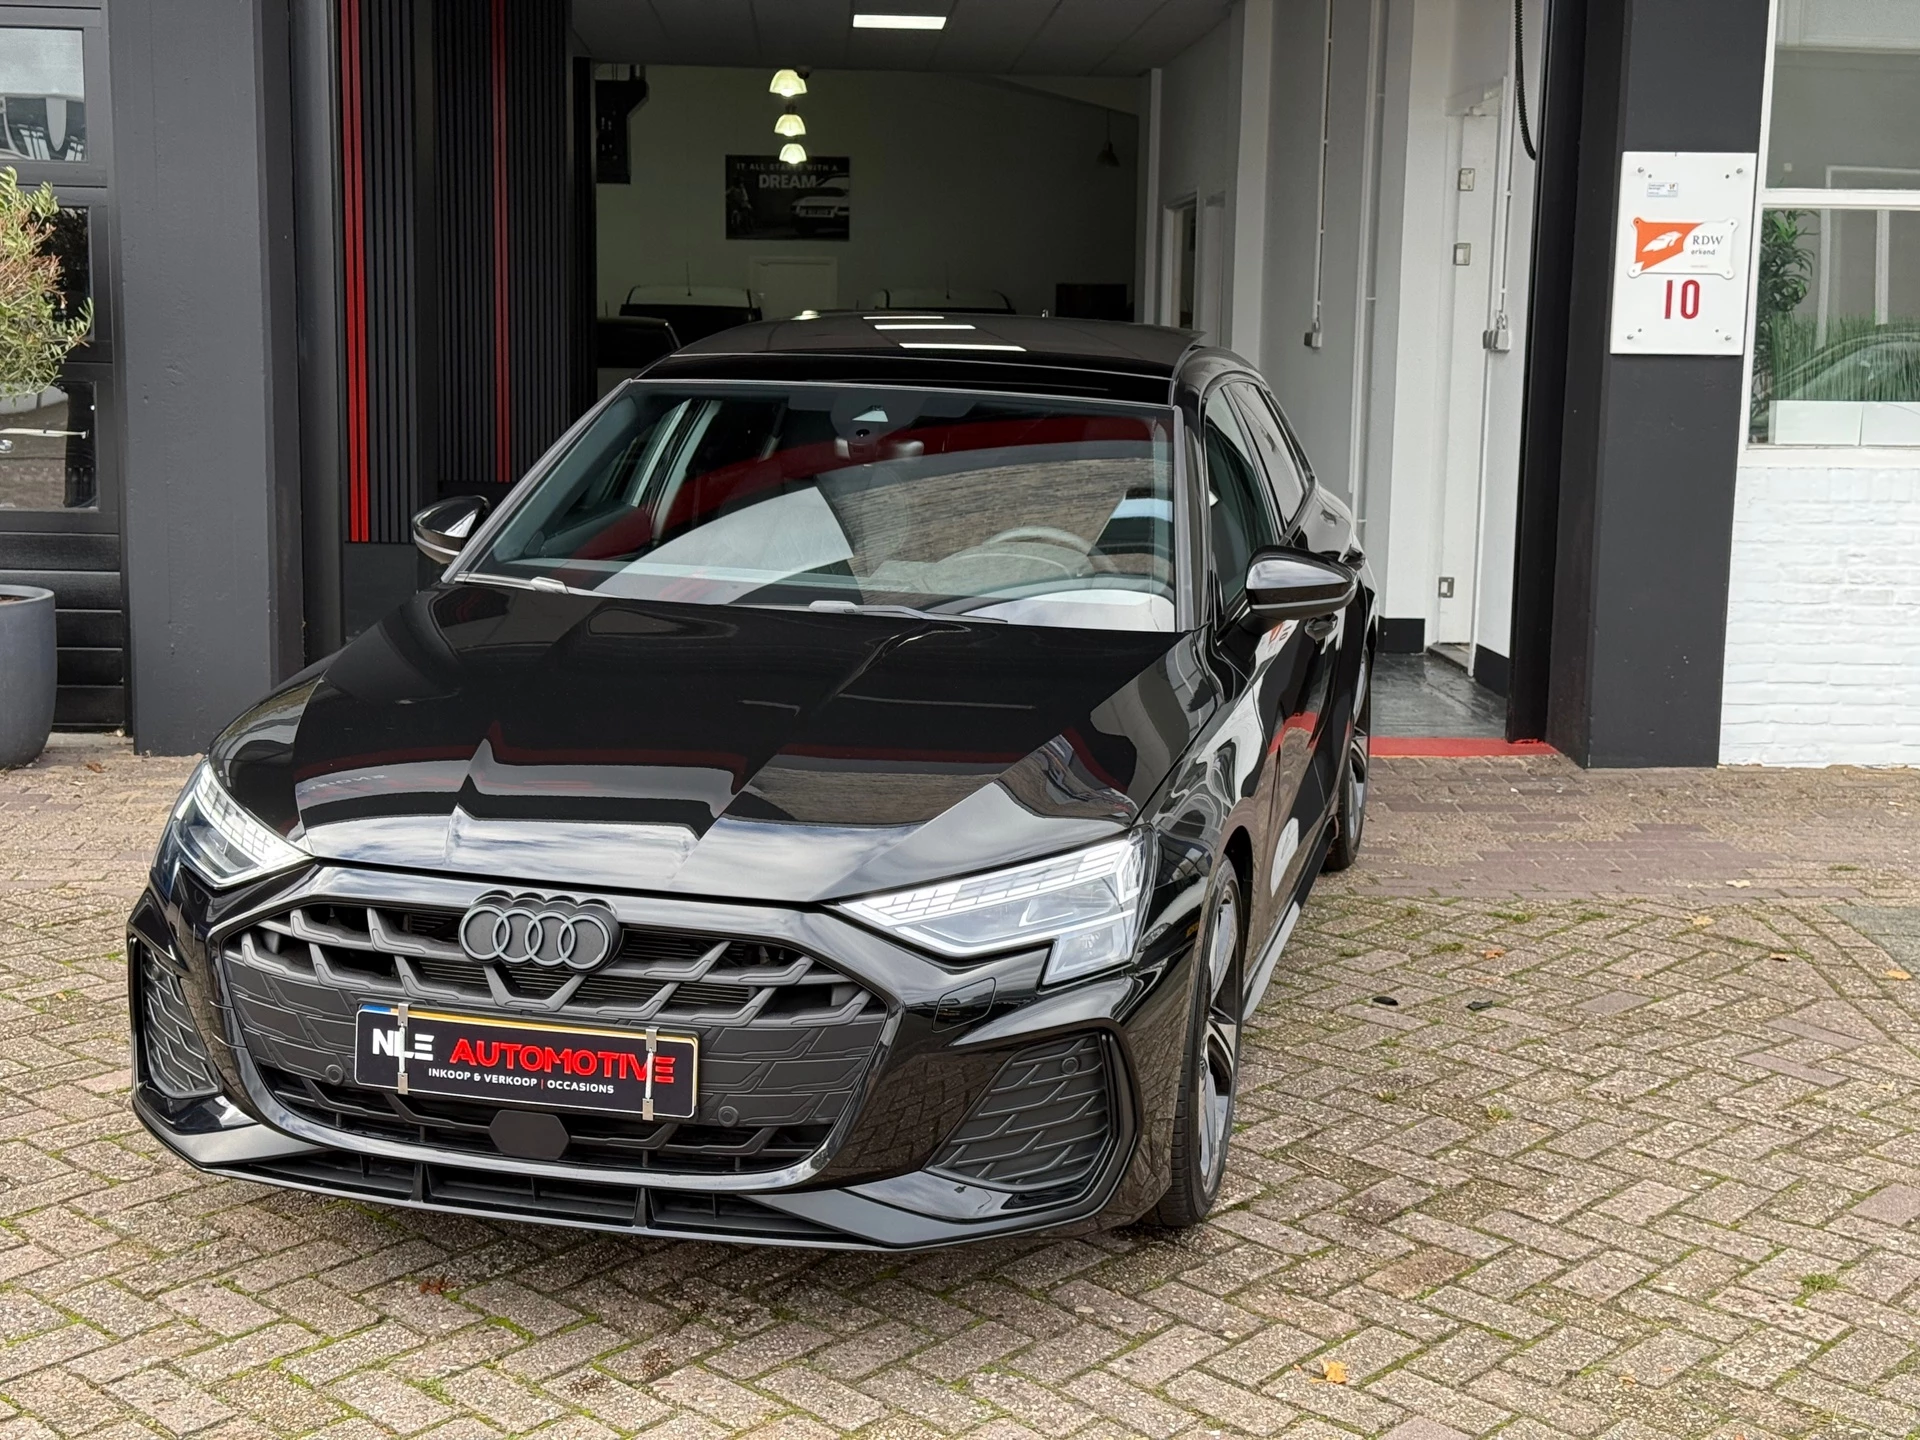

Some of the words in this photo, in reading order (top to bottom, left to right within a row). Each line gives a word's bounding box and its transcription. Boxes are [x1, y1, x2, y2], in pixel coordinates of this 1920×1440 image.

[736, 163, 746, 171] IT
[749, 163, 765, 171] ALL
[758, 174, 817, 189] DREAM
[1692, 235, 1724, 245] RDW
[1664, 279, 1701, 320] 10
[372, 1027, 435, 1062] NLE
[449, 1037, 676, 1084] AUTOMOTIVE
[428, 1067, 471, 1081] INKOOP
[474, 1072, 482, 1082] &
[483, 1073, 538, 1087] VERKOOP
[547, 1079, 615, 1094] OCCASIONS
